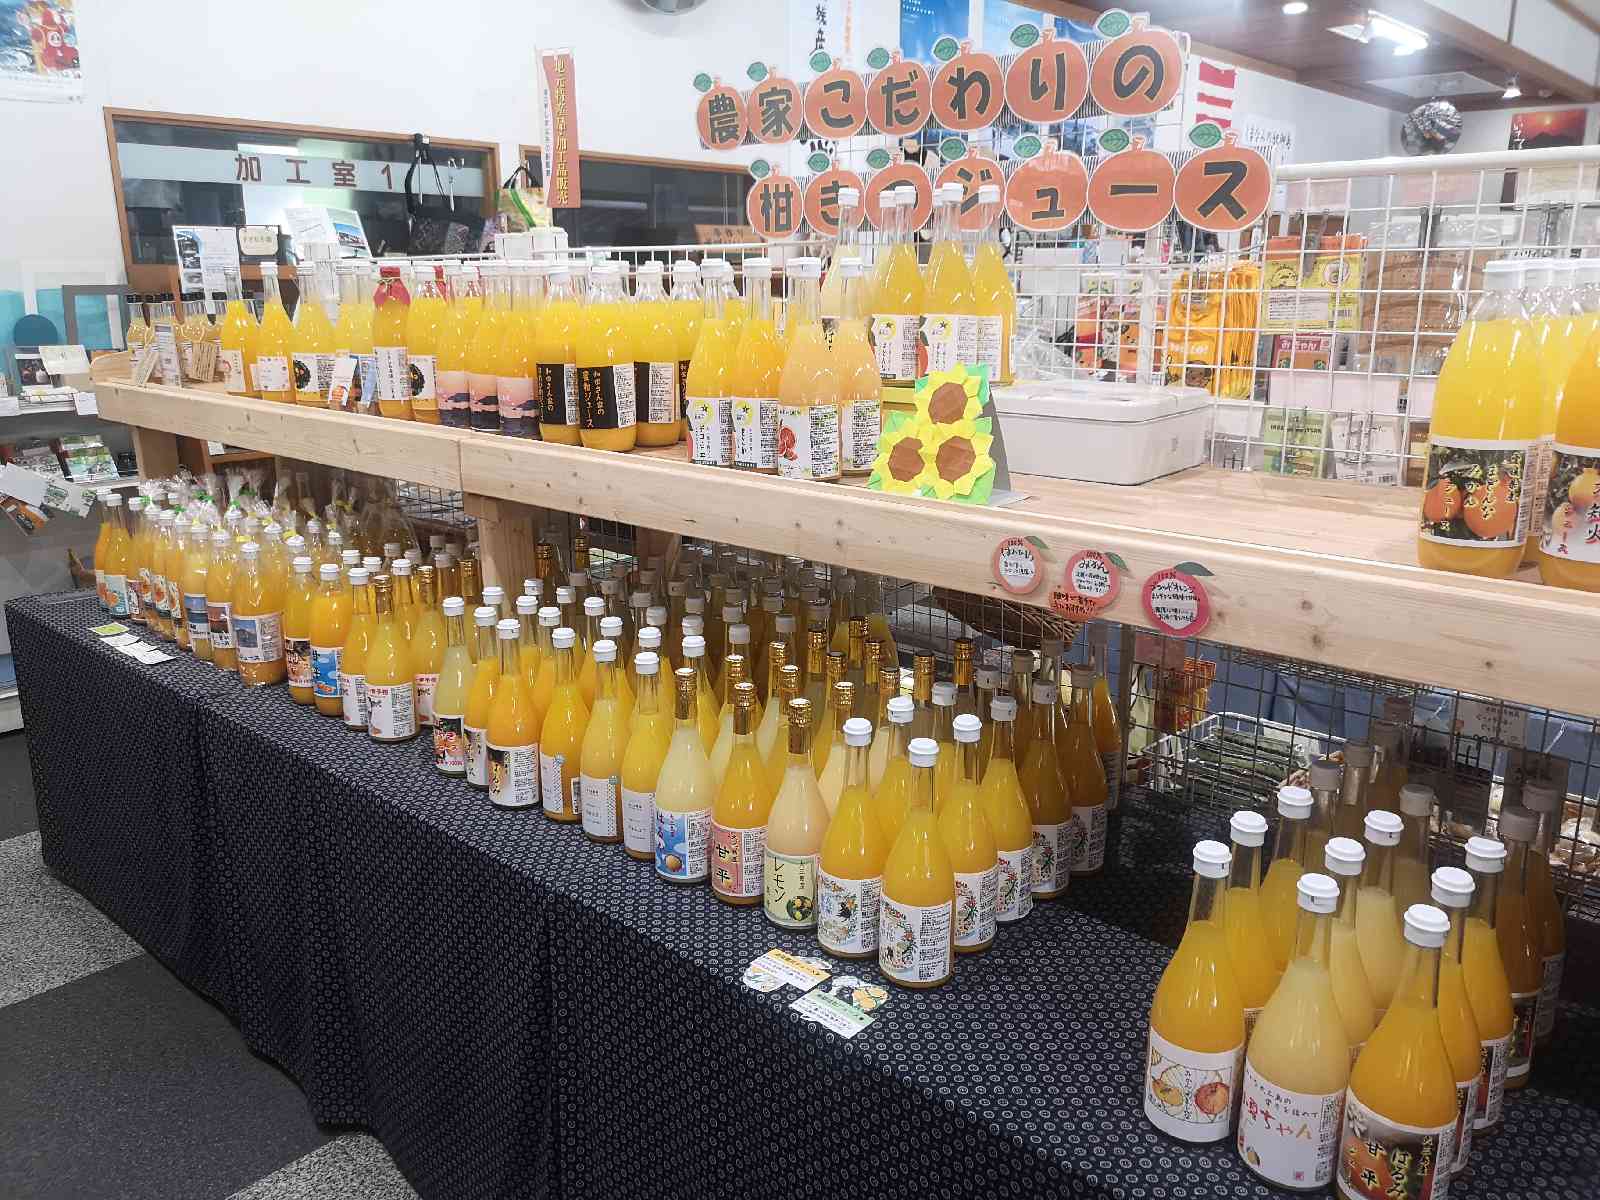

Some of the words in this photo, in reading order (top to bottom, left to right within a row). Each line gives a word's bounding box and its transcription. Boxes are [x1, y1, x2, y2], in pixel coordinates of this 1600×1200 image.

[709, 44, 1165, 144] 農家こだわりの
[235, 154, 393, 190] 加工室1
[716, 844, 730, 882] 甘平
[773, 856, 785, 903] レモン
[1361, 1140, 1386, 1186] 甘平
